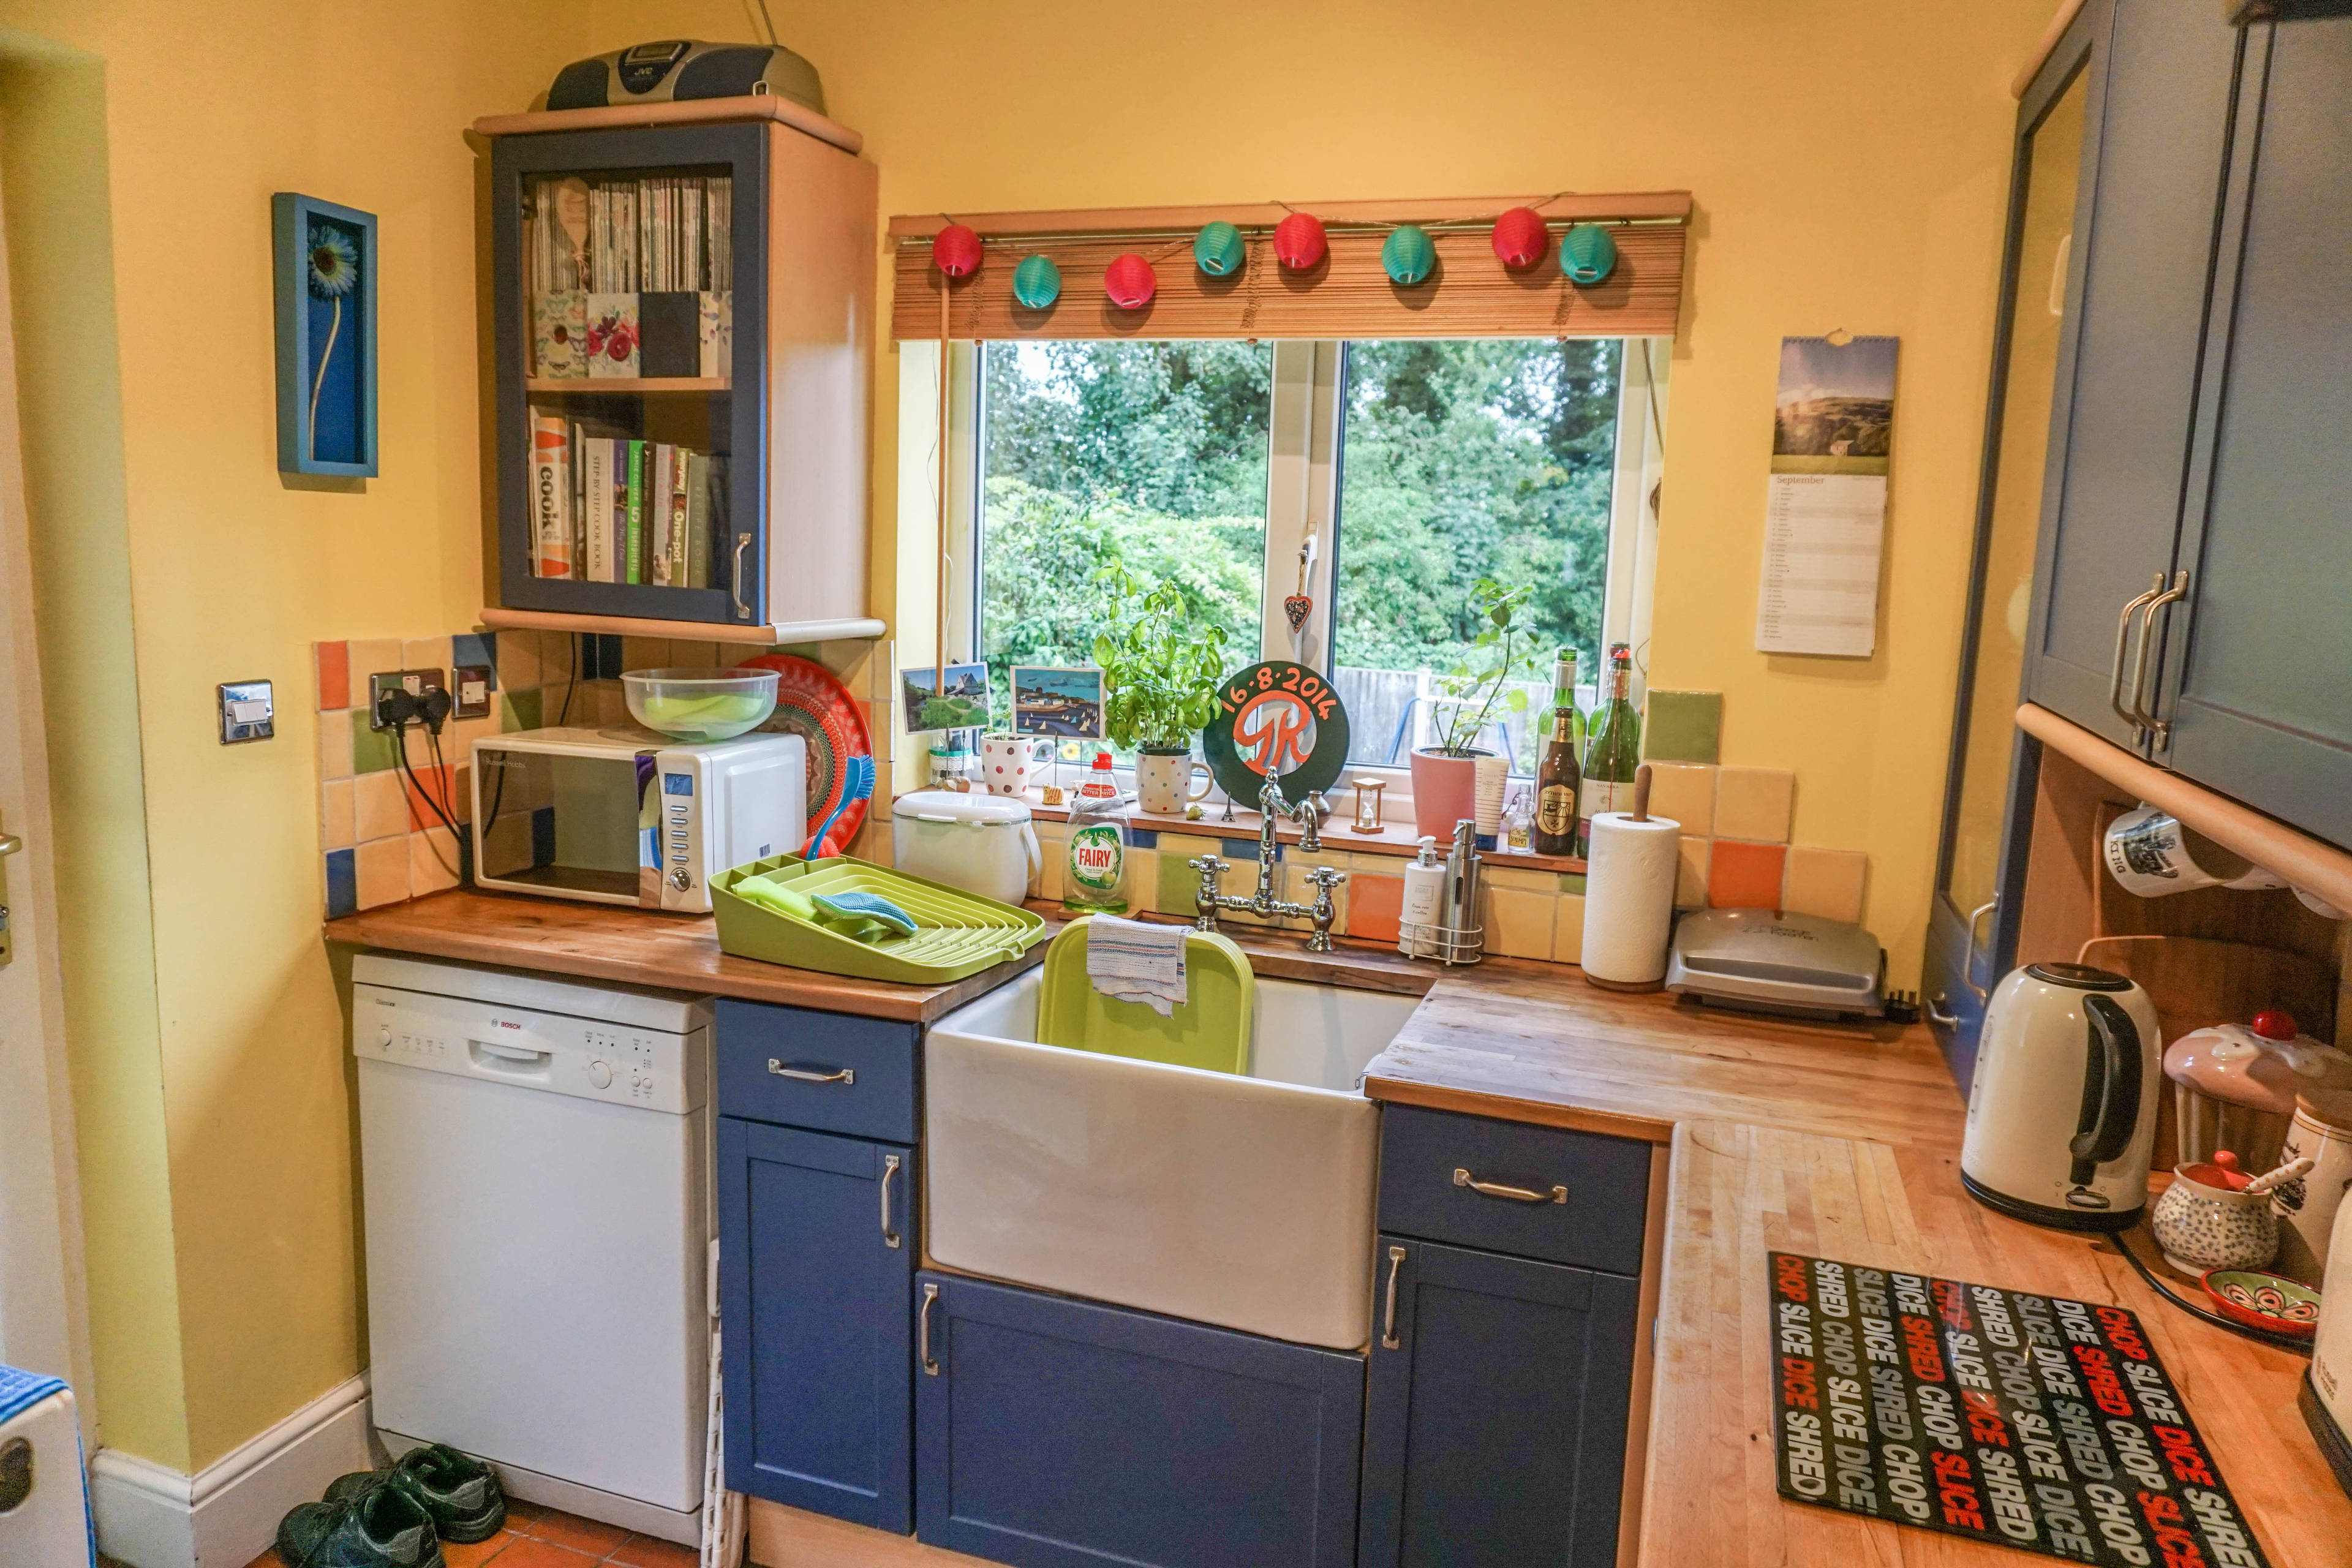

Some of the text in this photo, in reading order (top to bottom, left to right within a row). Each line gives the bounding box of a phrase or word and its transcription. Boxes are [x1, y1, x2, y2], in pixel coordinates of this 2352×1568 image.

[677, 451, 686, 491] everyday
[1777, 475, 1825, 485] September
[631, 506, 640, 523] 5
[673, 511, 684, 564] One-pot
[1079, 848, 1112, 868] FAIRY
[500, 1021, 521, 1030] BOSCH
[2052, 1299, 2101, 1345] DICE
[1777, 1256, 1826, 1496] CHOP SLICE DICE SHRED
[1814, 1261, 1877, 1509] SHRED CHOP SLICE DICE
[1853, 1268, 1930, 1519] SLICE DICE SHRED CHOP
[1891, 1273, 1985, 1531] DICE SHRED CHOP SLICE
[1932, 1281, 2038, 1540] CHOP SLICE DICE SHRED
[2073, 1345, 2133, 1416] SHRED
[1971, 1287, 2094, 1556] SHRED CHOP SLICE DICE
[2013, 1294, 2151, 1566] SLICE DICE SHRED CHOP
[2096, 1307, 2263, 1568] CHOP SLICE DICE SHRE
[2106, 1420, 2168, 1490] CHOP
